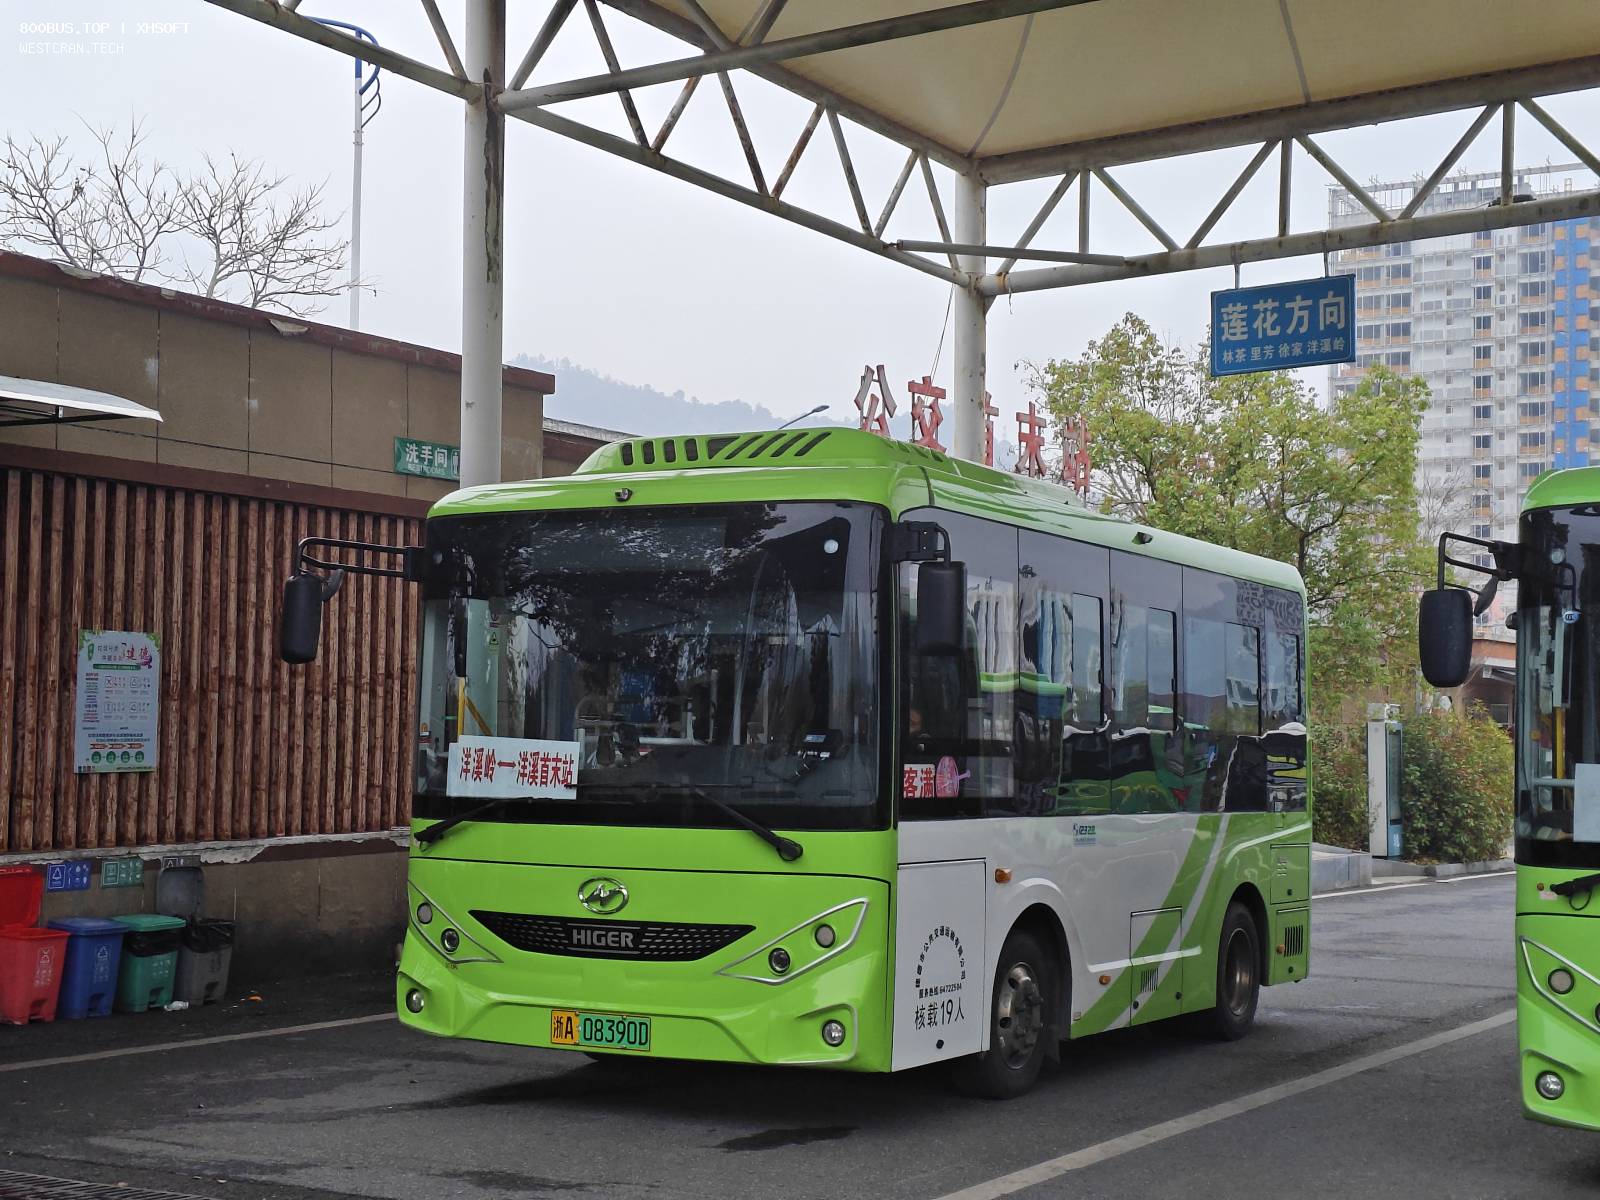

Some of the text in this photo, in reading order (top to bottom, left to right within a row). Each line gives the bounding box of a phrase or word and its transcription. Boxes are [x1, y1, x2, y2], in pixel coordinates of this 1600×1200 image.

[1221, 291, 1345, 342] 莲花方向
[1250, 345, 1275, 361] 里芳
[1278, 341, 1303, 358] 徐家
[1307, 337, 1345, 354] 洋溪岭
[406, 443, 447, 468] 洗手间
[460, 747, 574, 788] 洋溪岭 洋溪首末站
[904, 767, 934, 798] 客满
[572, 929, 634, 948] HIGER
[915, 997, 965, 1030] 核载19人
[553, 1015, 649, 1046] 浙A08390D
